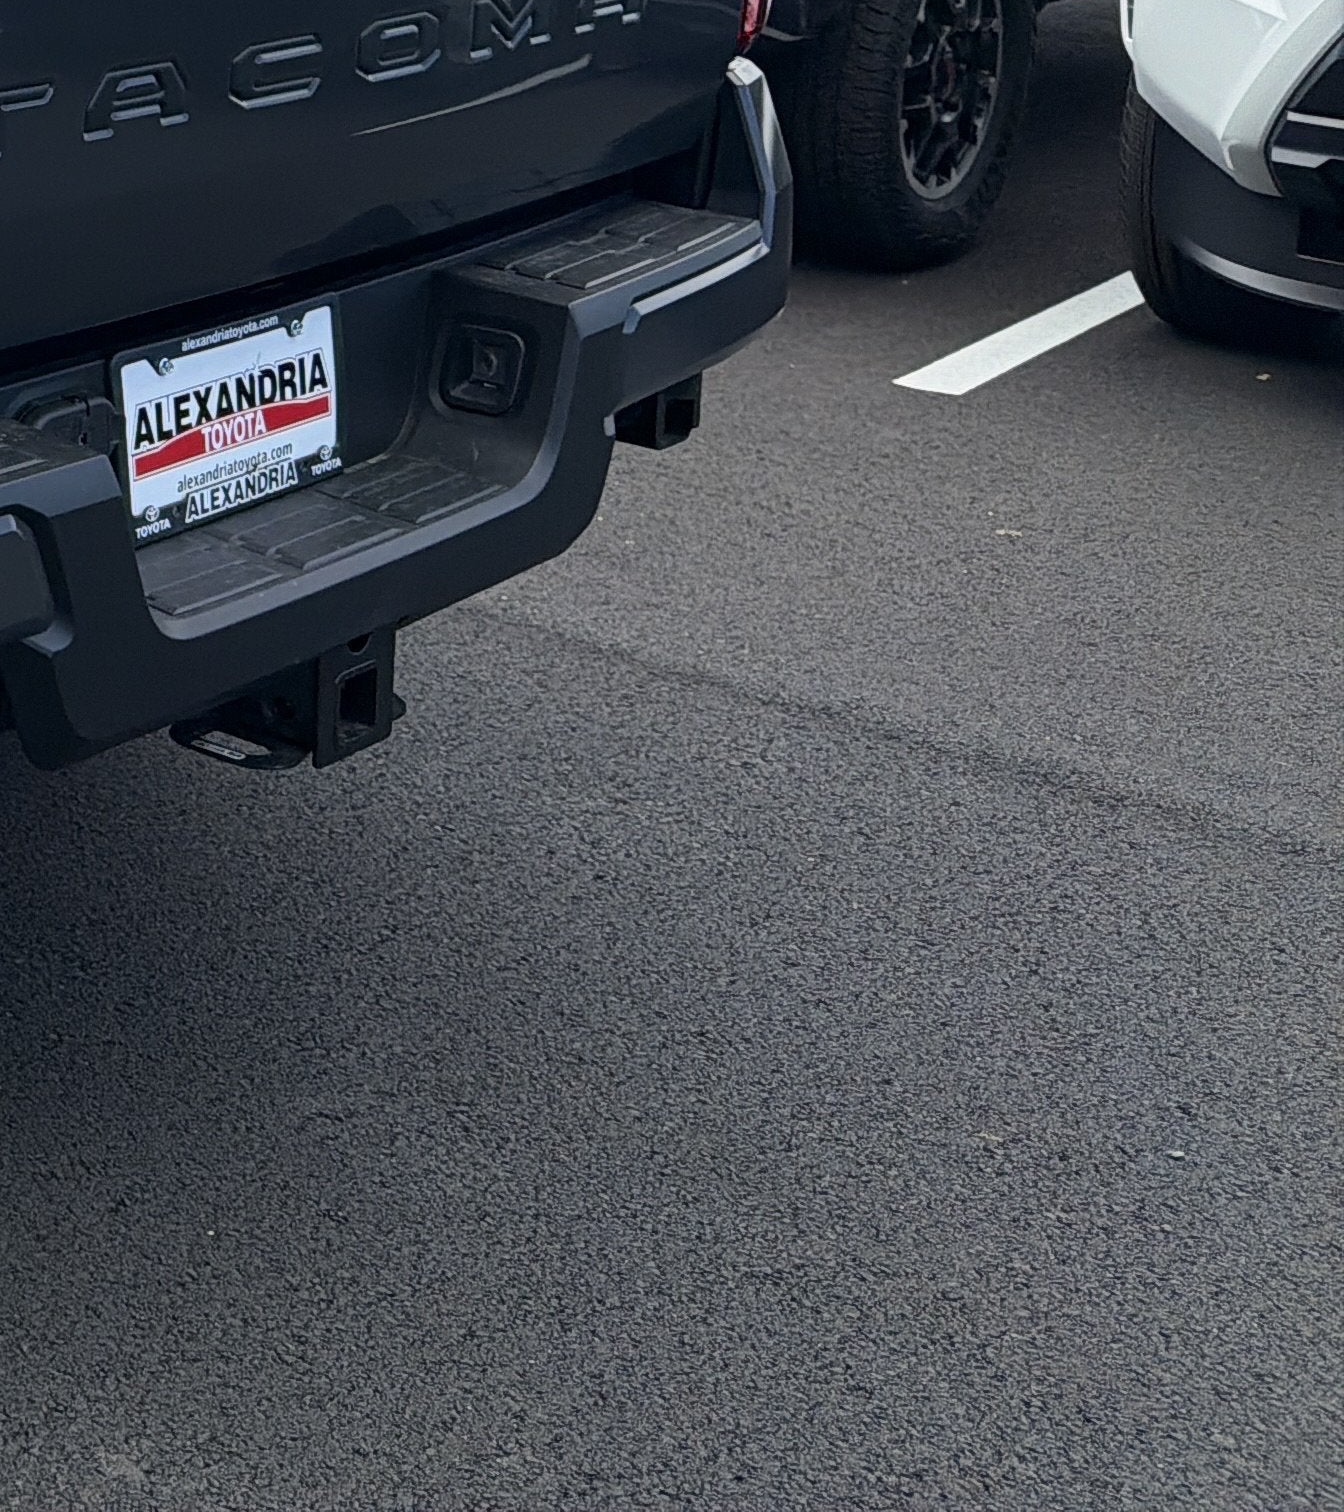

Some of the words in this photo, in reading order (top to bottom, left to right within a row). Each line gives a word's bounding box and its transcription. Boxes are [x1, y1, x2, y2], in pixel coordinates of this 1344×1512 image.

[181, 315, 279, 352] alexandriatoyota.com
[133, 351, 329, 451] ALEXANDRIA
[202, 409, 267, 452] TOYOTA
[176, 441, 294, 494] alexandriatoyota.com
[310, 457, 343, 477] TOYOTA
[185, 459, 299, 523] ALEXANDRIA
[134, 517, 172, 539] TOYOTA
